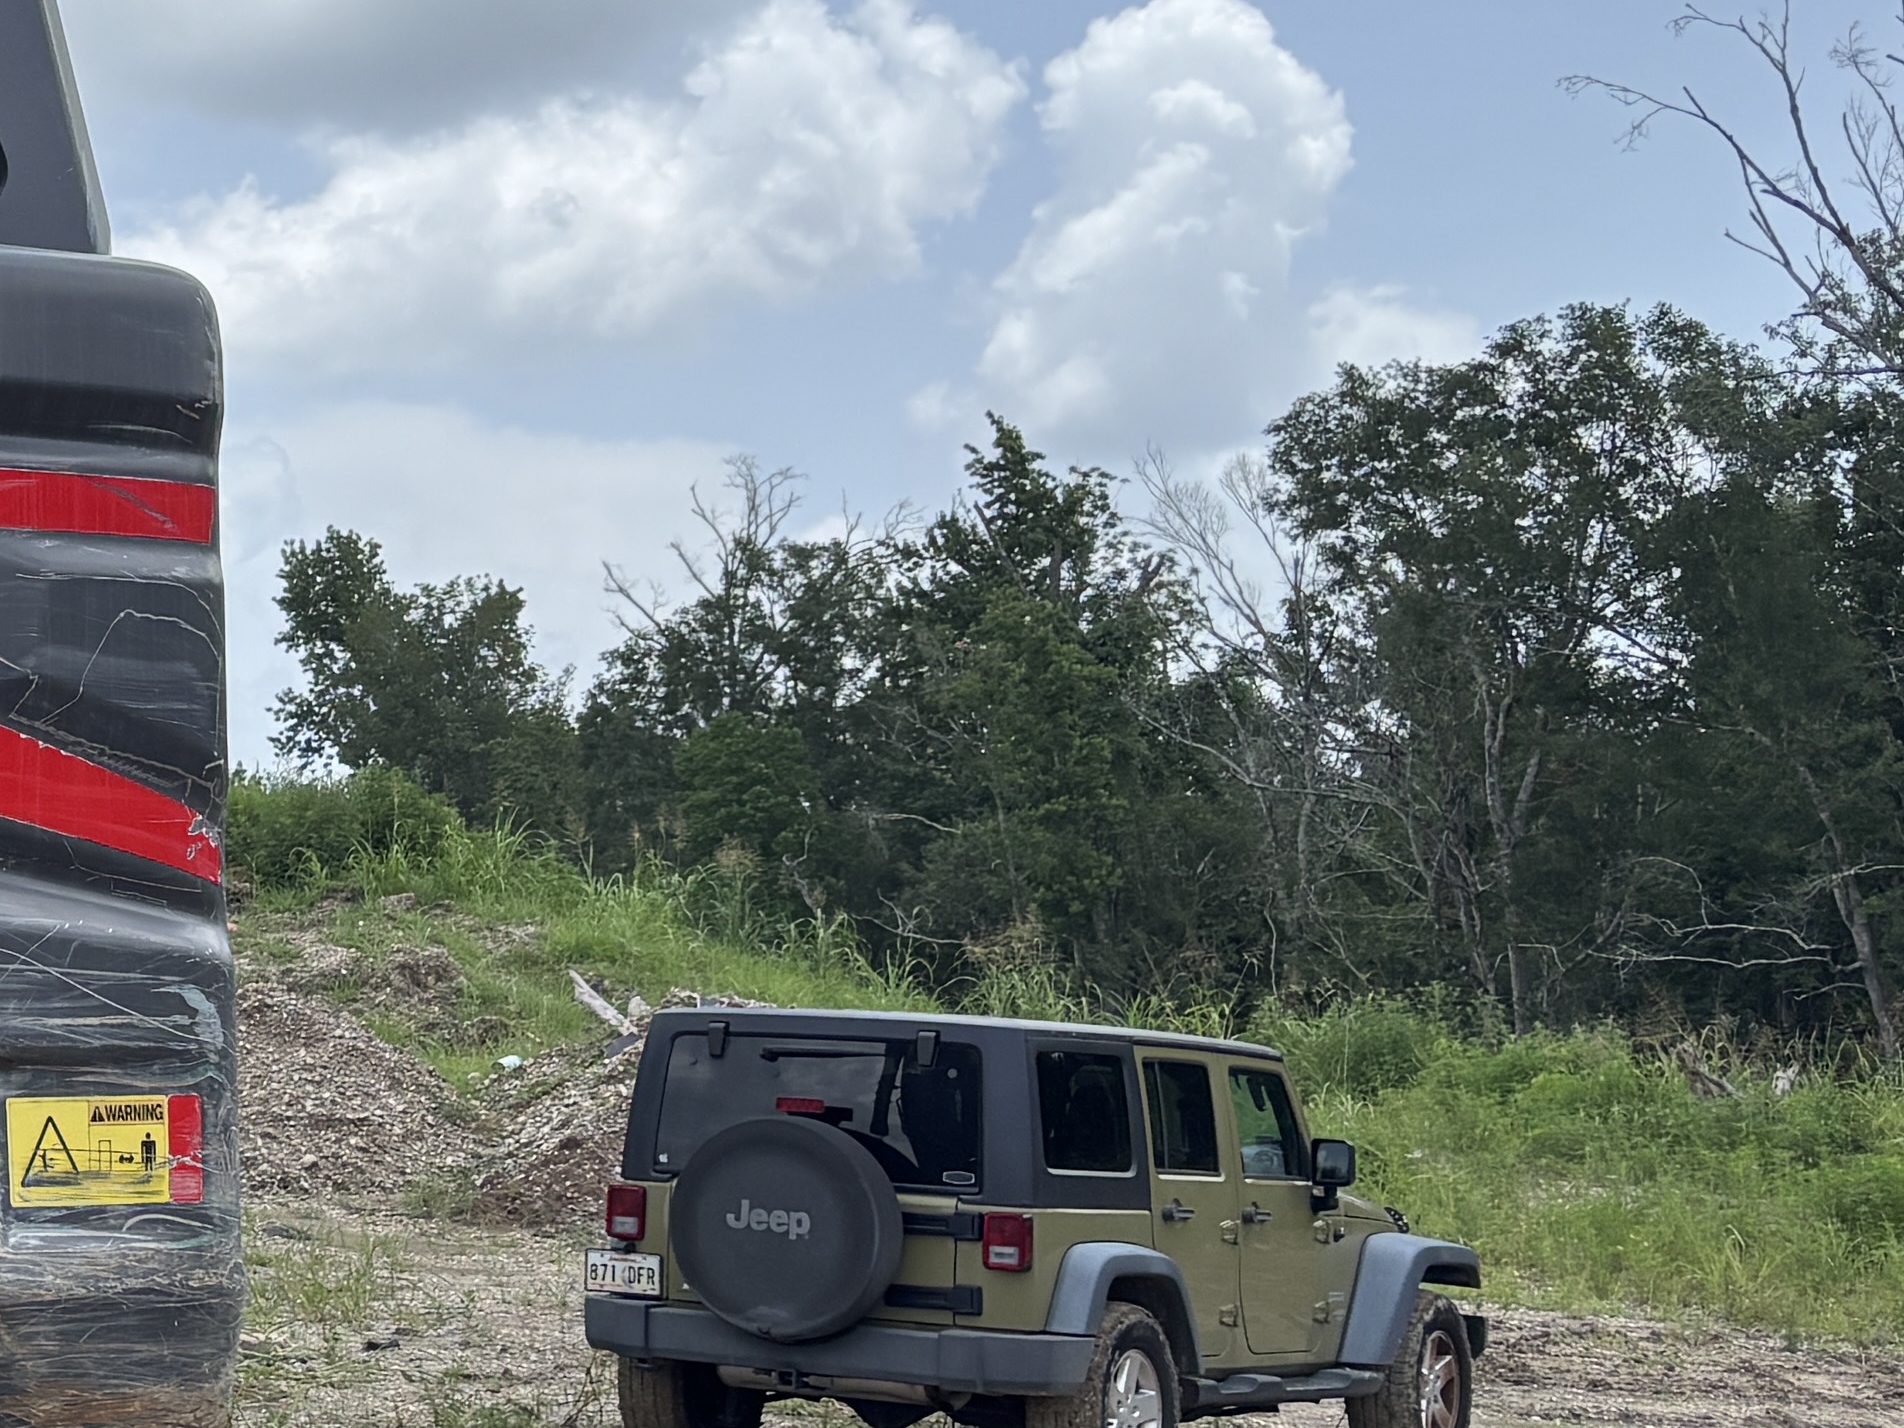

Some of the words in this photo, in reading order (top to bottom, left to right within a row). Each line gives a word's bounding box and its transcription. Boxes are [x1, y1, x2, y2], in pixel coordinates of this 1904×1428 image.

[104, 1103, 164, 1122] WARNING
[725, 1199, 811, 1240] Jeep
[589, 1263, 616, 1283] 871
[627, 1265, 656, 1286] DFR
